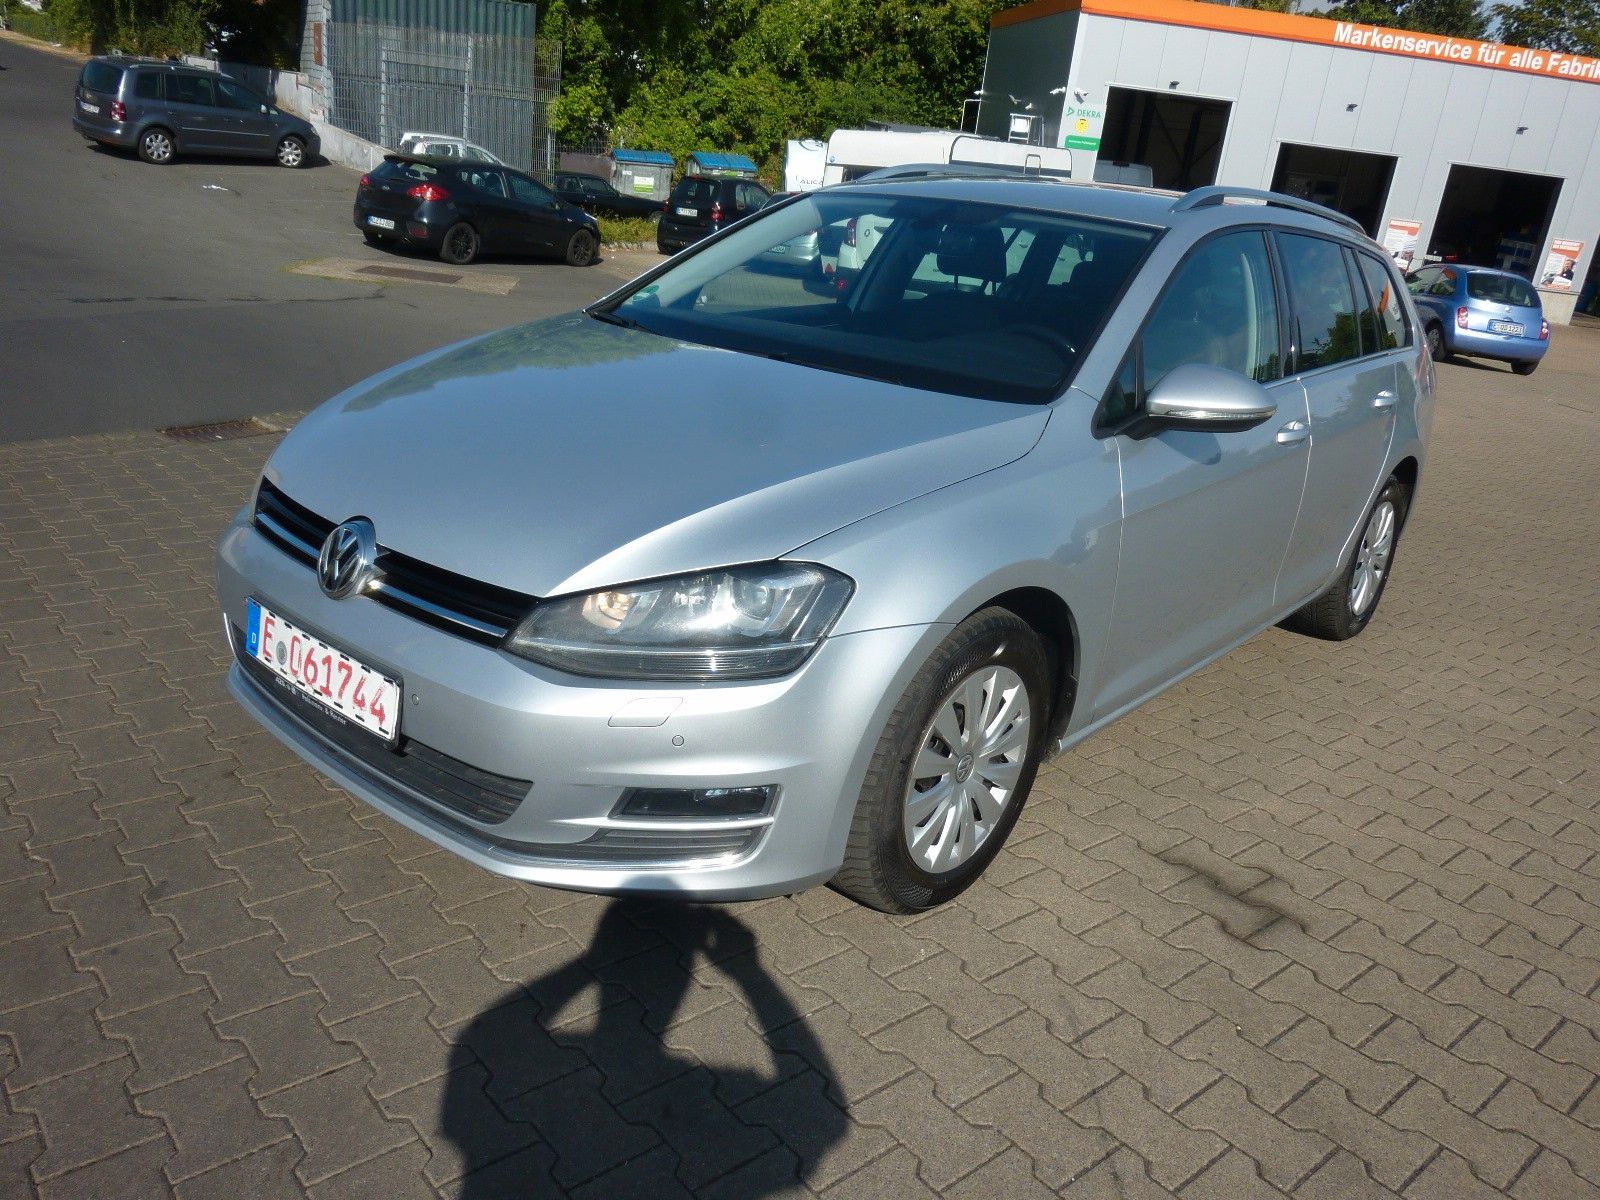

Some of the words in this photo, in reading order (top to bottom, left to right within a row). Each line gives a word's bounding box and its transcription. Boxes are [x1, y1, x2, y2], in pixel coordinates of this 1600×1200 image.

[1334, 23, 1471, 59] Markenservice
[1476, 44, 1505, 65] für
[1509, 50, 1542, 71] alle
[1077, 109, 1101, 118] DEKRA
